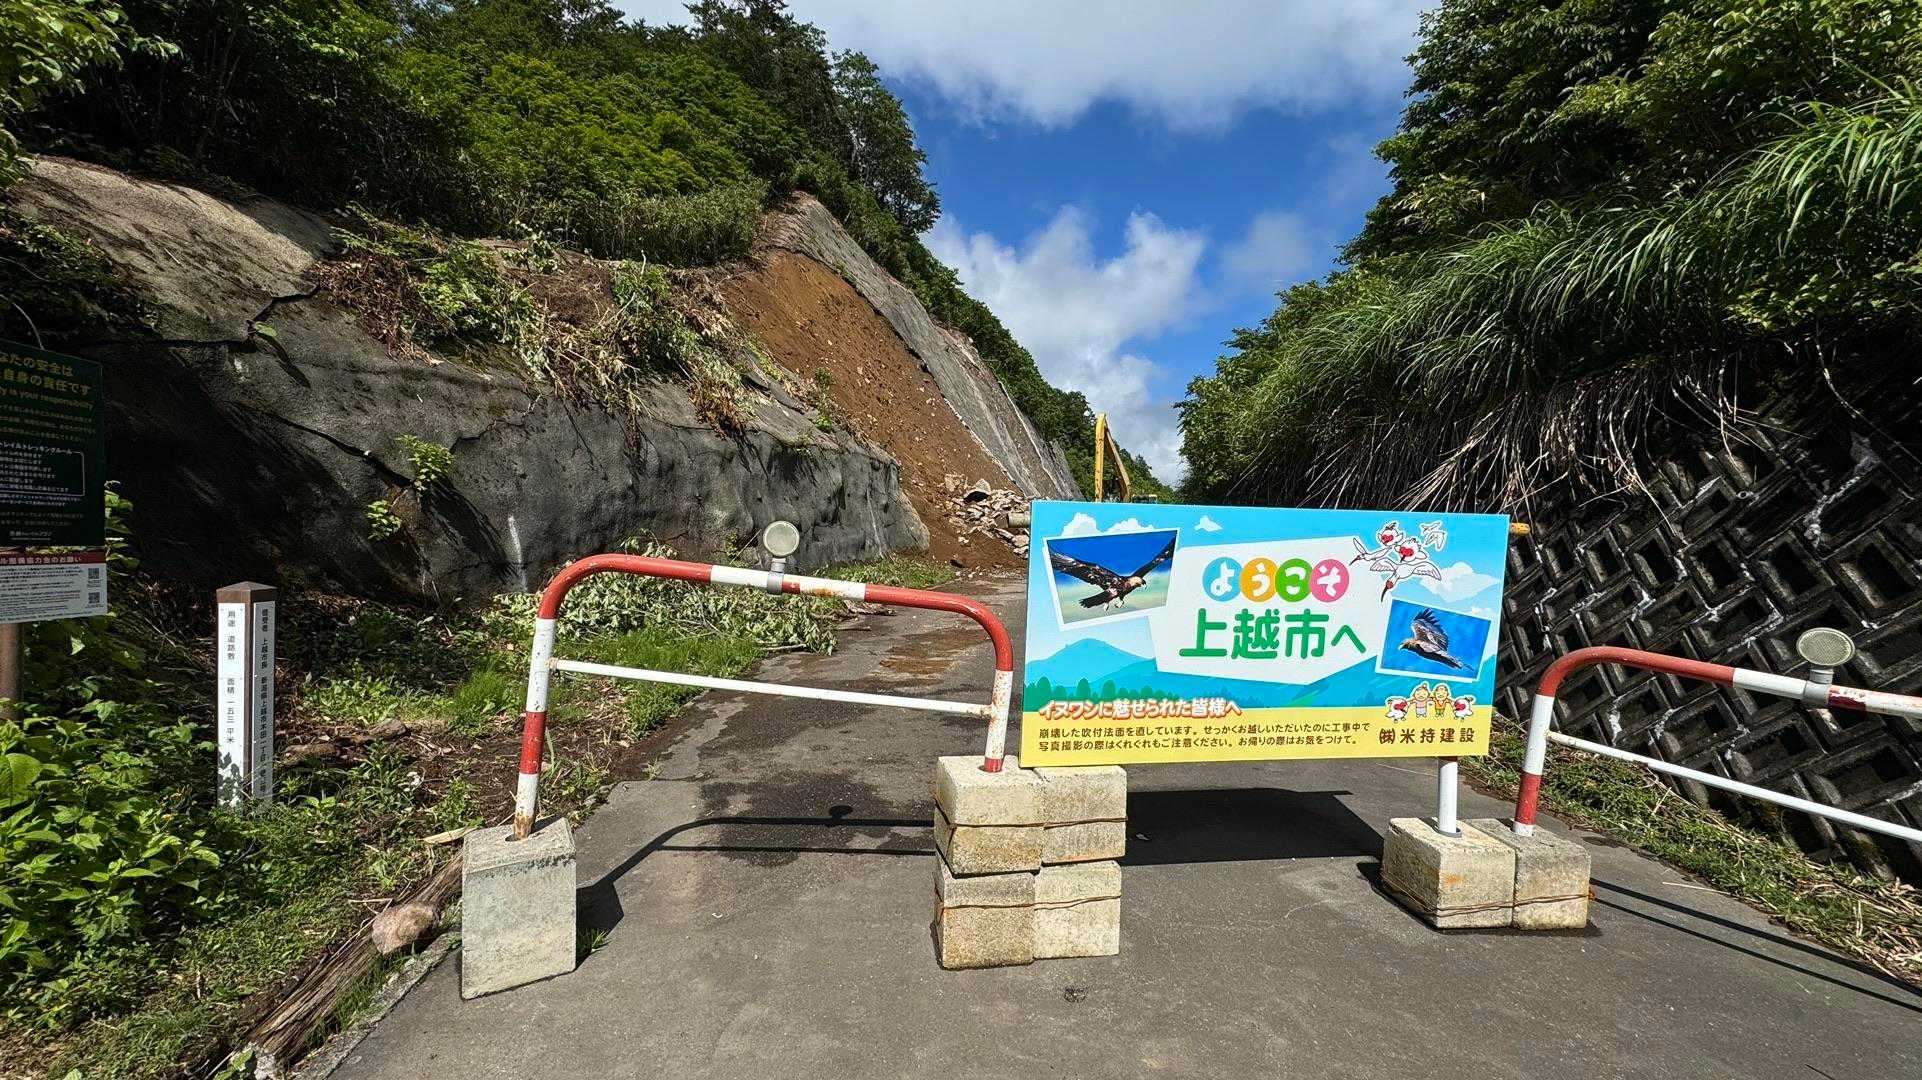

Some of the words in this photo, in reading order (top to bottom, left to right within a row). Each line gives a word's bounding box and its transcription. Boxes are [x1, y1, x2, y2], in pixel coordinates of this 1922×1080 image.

[0, 368, 91, 395] 自身の責任です
[1208, 559, 1343, 598] ようこそ
[1179, 608, 1366, 660] 上越市へ
